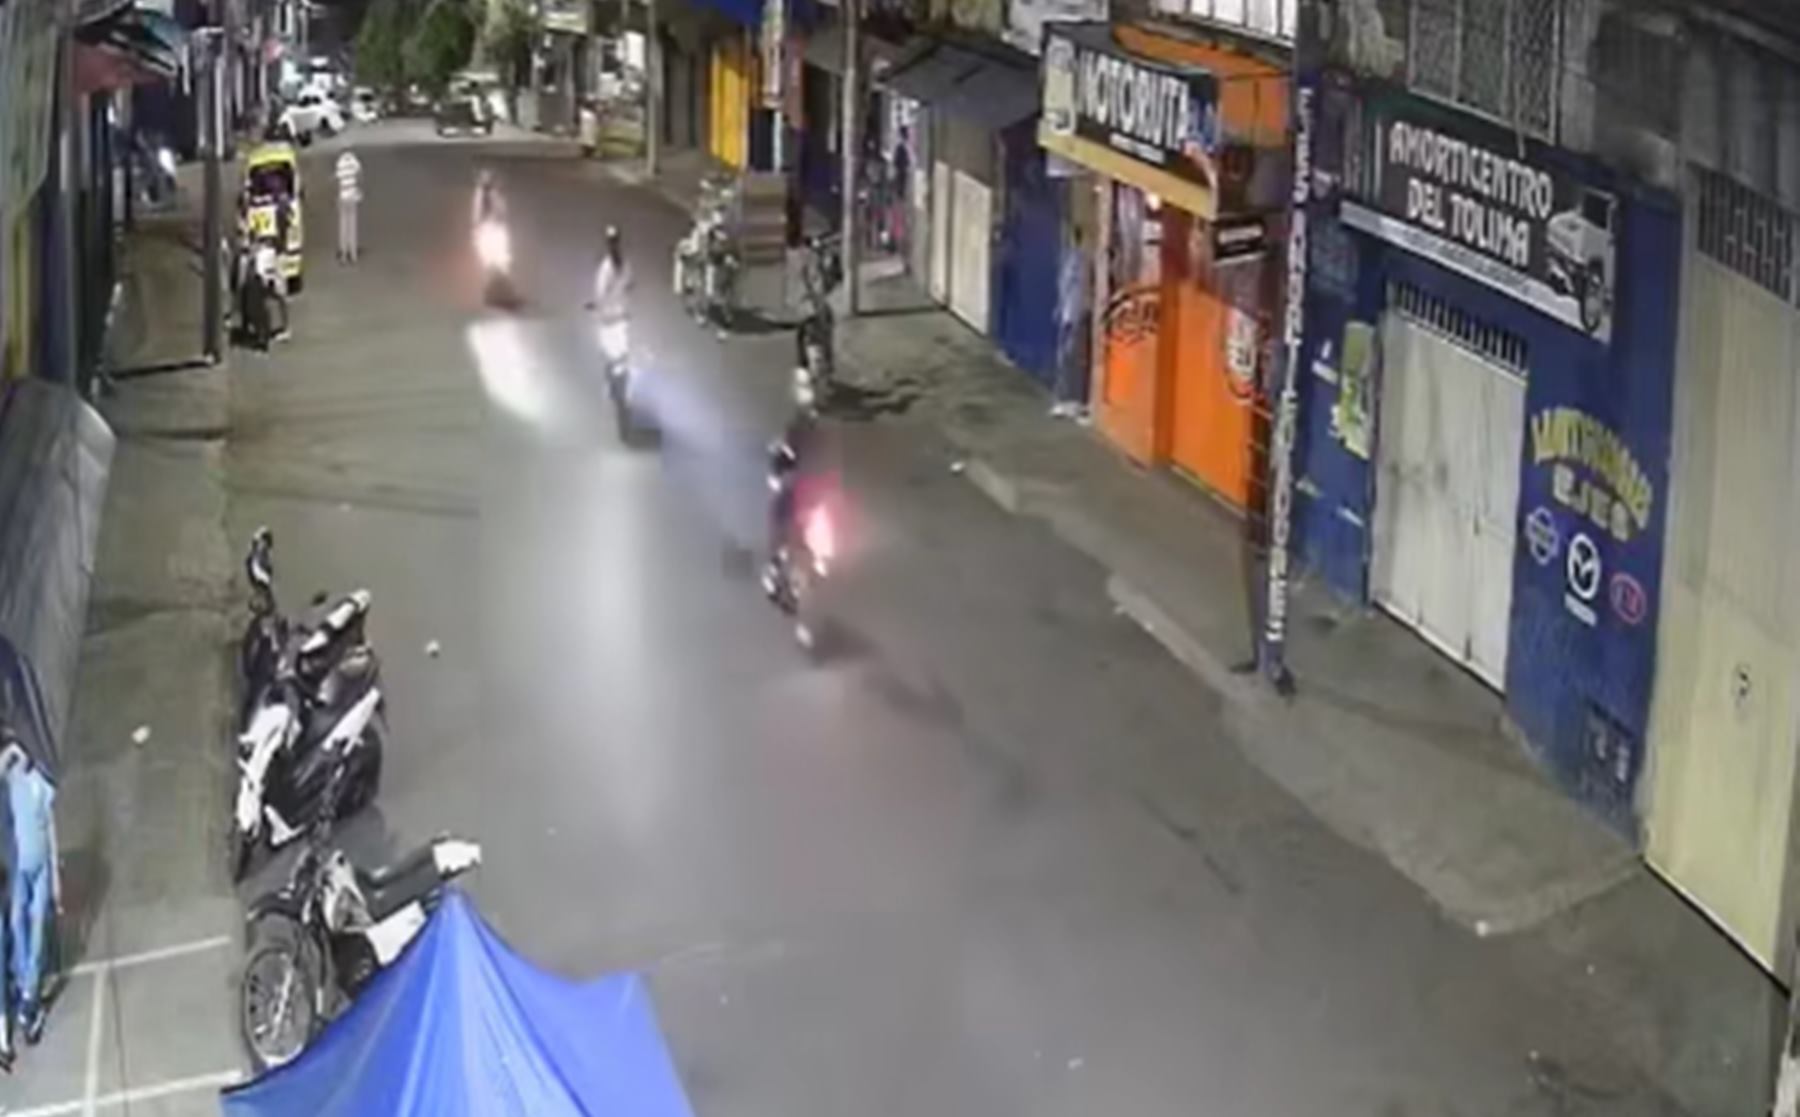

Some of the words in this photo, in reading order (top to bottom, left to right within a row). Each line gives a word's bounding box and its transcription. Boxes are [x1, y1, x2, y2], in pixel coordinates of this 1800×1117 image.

[1389, 121, 1553, 219] AMORTICENTRO
[1408, 178, 1445, 229] DEL
[1450, 193, 1530, 267] TOLIMA
